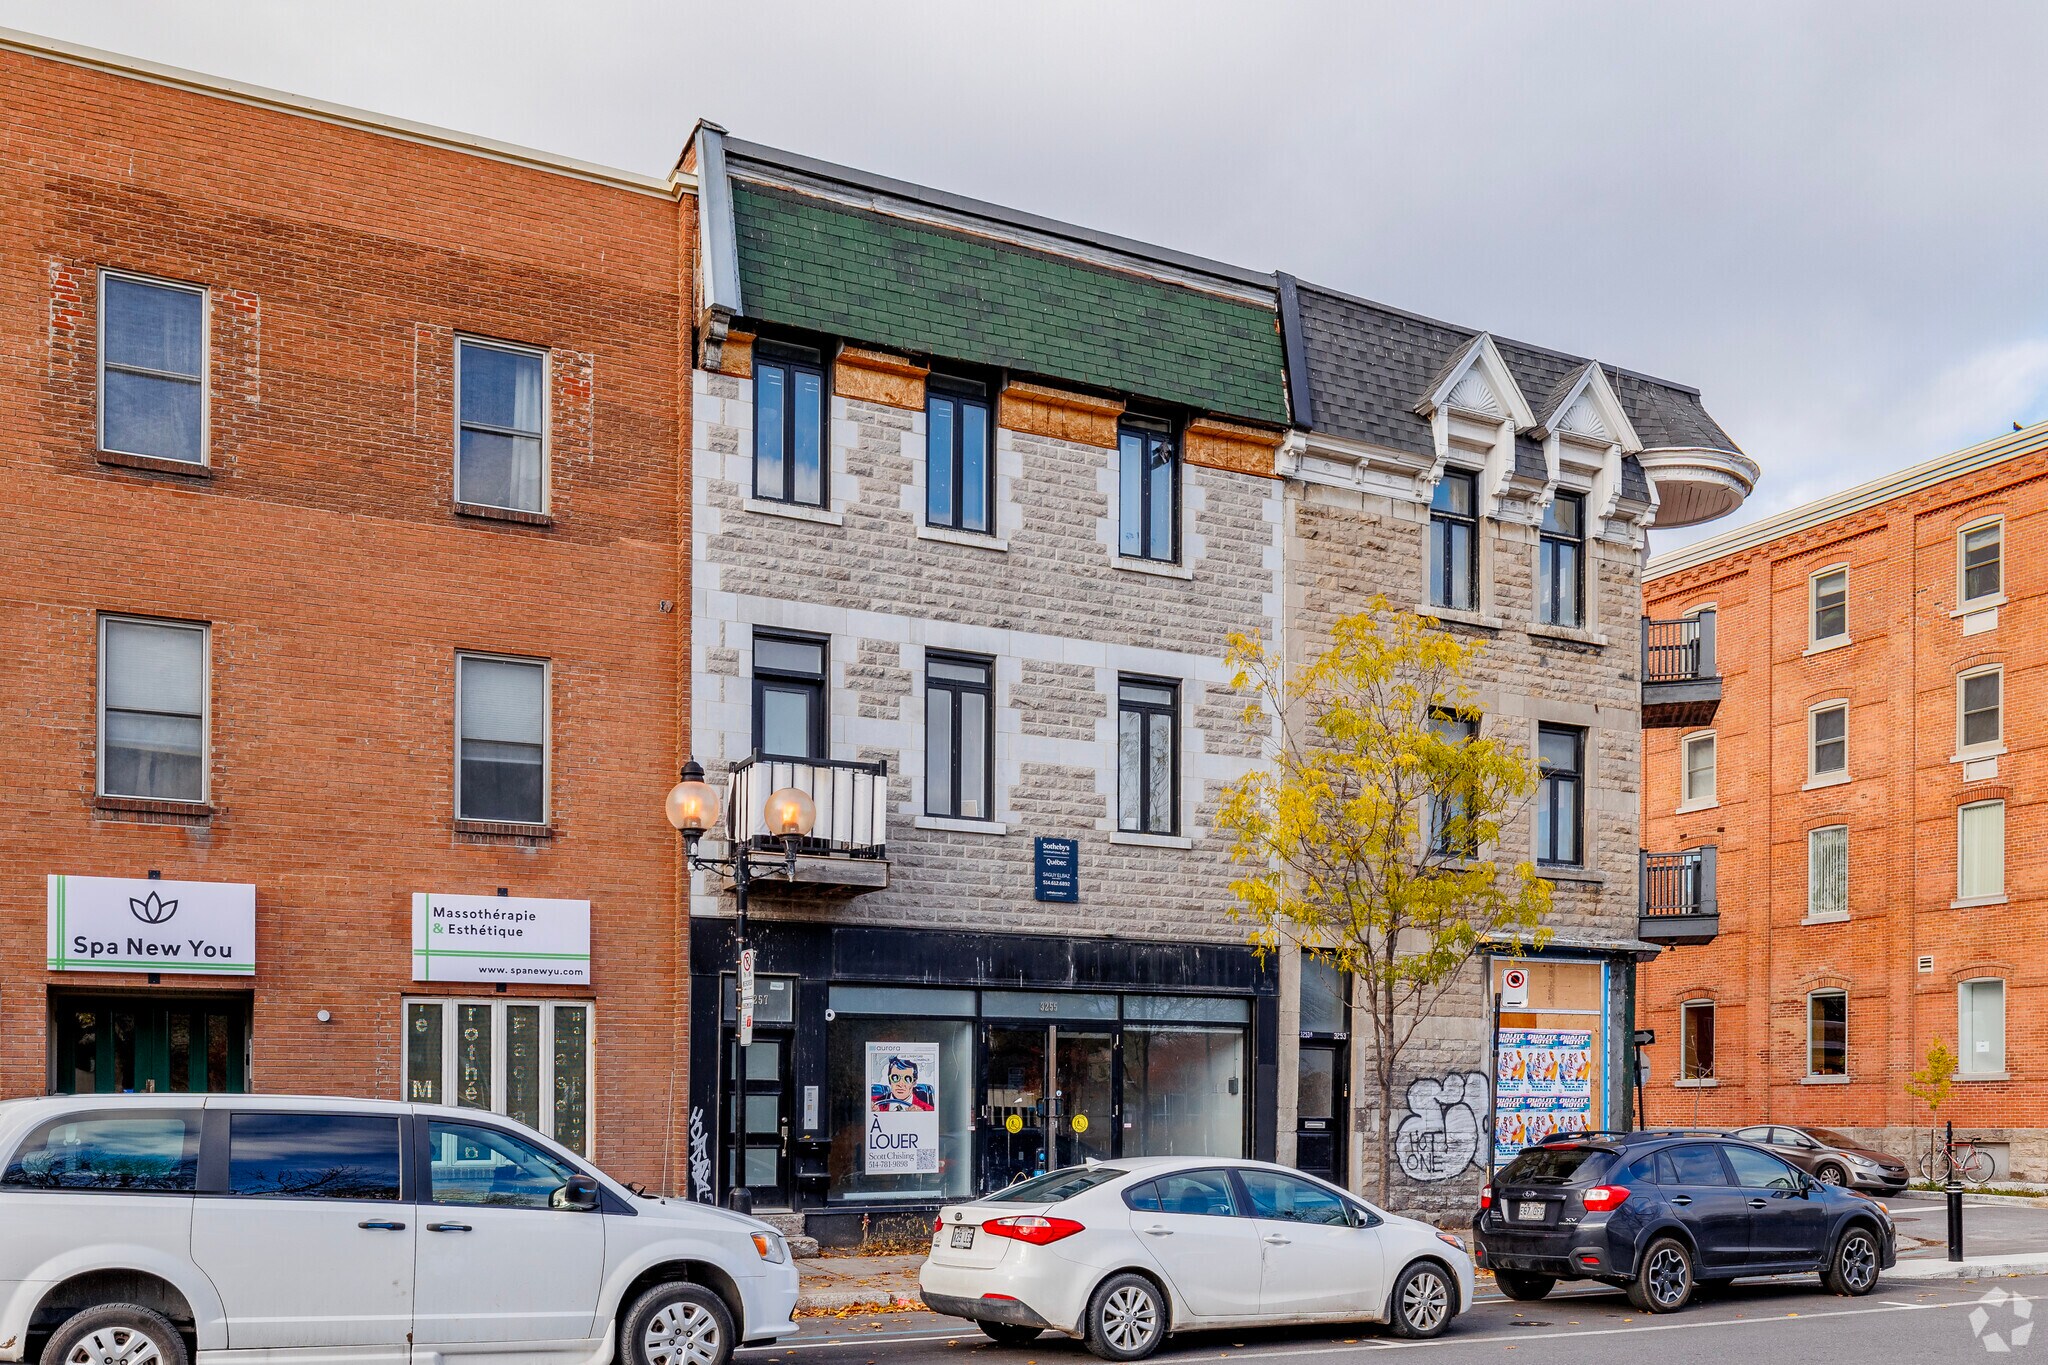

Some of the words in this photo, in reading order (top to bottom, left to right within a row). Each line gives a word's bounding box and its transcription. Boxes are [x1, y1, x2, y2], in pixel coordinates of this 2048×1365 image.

[1042, 843, 1070, 851] Sotheby's
[1046, 858, 1067, 866] Québec
[433, 907, 537, 923] Massothérapie
[433, 923, 444, 934] &
[448, 923, 524, 938] Esthétique
[73, 936, 118, 958] Spa
[126, 938, 181, 956] New
[188, 940, 232, 957] You
[753, 994, 769, 1005] 257
[1040, 1001, 1058, 1012] 3255
[1333, 1032, 1347, 1040] 3253
[870, 1113, 882, 1133] À
[869, 1133, 919, 1149] LOUER
[868, 1152, 886, 1160] Scott
[886, 1151, 915, 1161] Chisling
[1406, 1153, 1444, 1173] ONE
